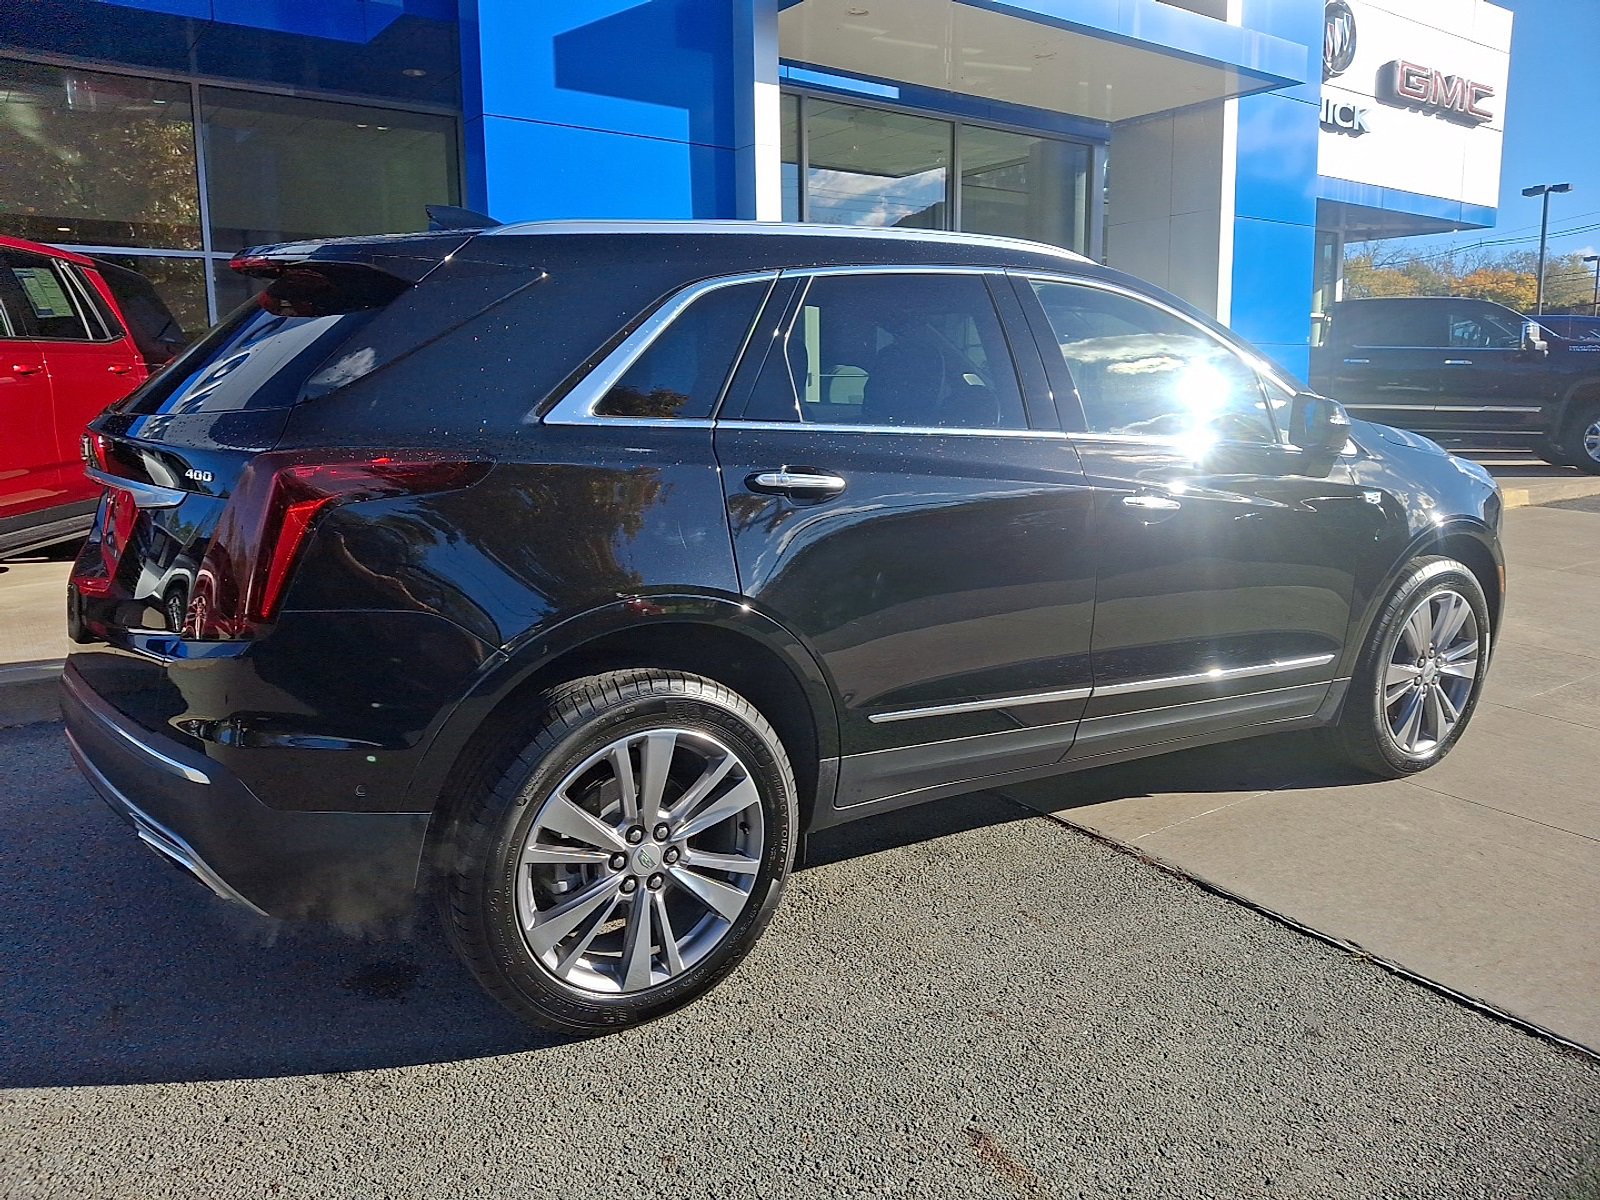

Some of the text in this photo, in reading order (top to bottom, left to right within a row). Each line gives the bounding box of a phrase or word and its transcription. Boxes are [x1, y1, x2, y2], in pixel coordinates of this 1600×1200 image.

[1397, 60, 1494, 120] GMC
[184, 468, 213, 482] 400
[780, 823, 790, 854] TOUR
